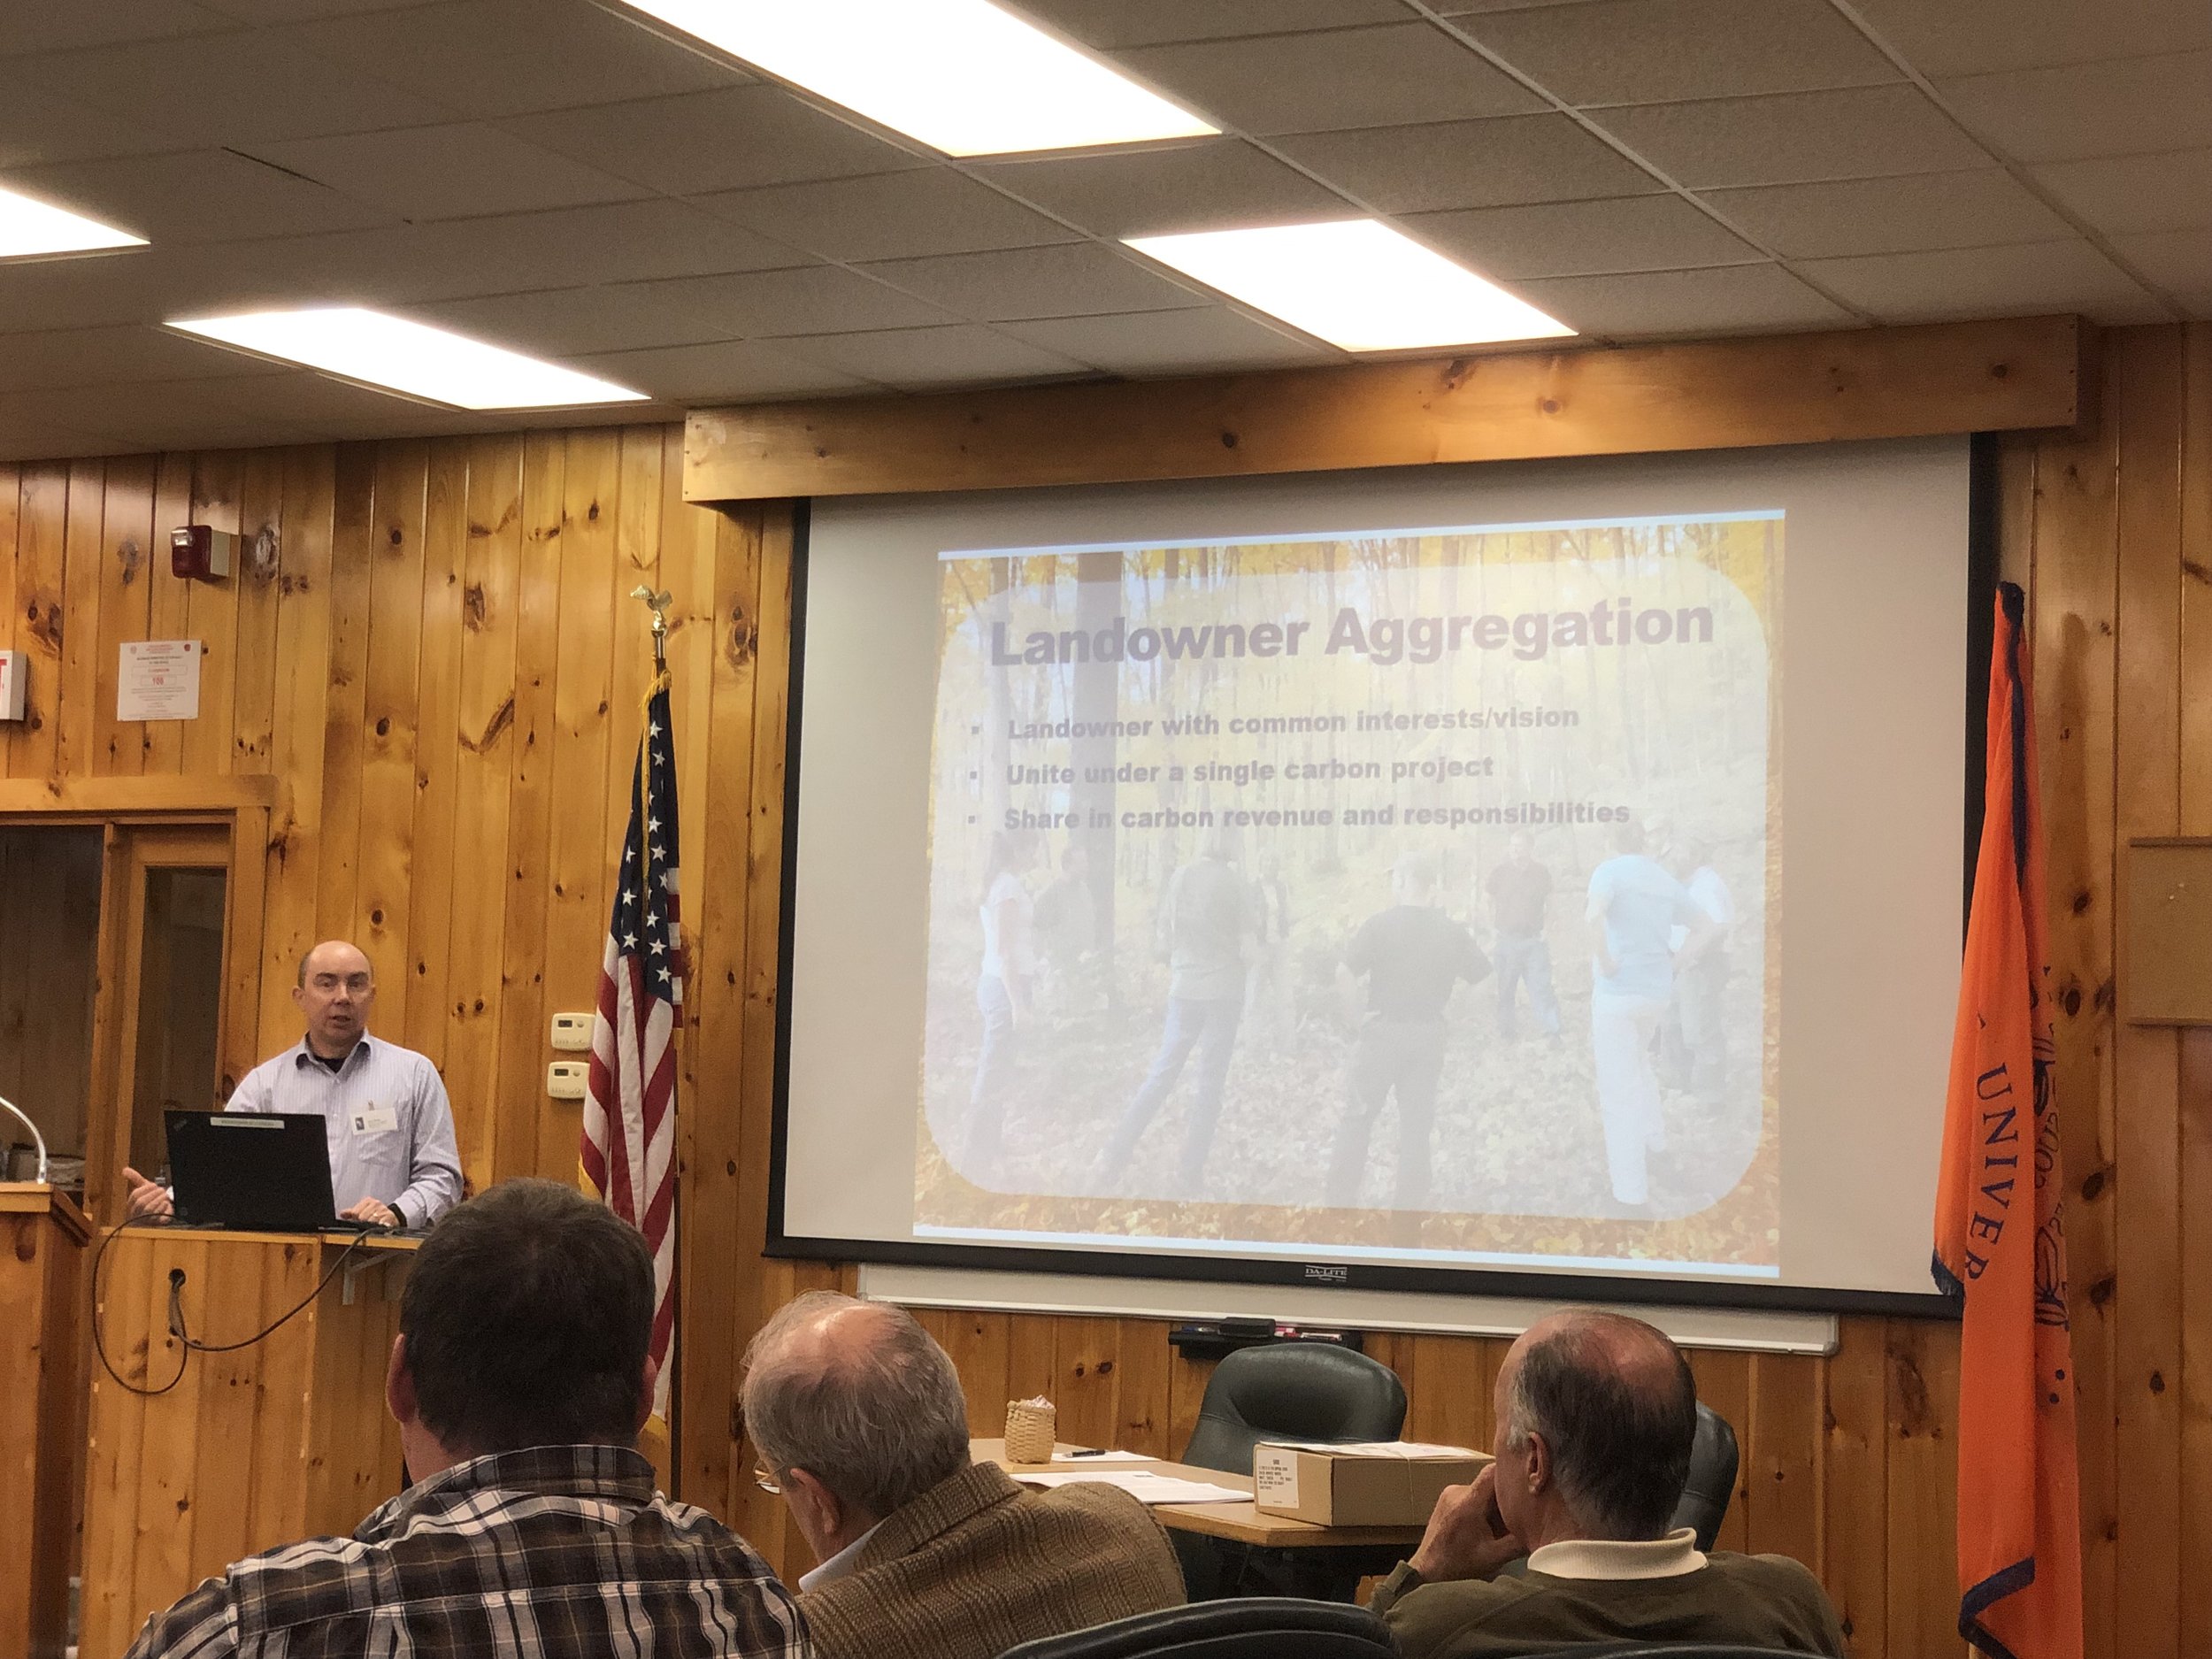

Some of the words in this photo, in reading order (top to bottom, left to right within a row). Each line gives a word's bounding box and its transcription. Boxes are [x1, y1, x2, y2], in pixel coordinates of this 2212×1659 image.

[991, 617, 1310, 666] Landowner
[1325, 596, 1714, 665] Aggregation
[1008, 718, 1153, 740] Landowner
[1161, 714, 1219, 736] with
[1229, 715, 1346, 734] common
[1356, 706, 1579, 732] interests/vision
[1006, 764, 1075, 786] Unite
[1084, 763, 1161, 784] under
[1169, 767, 1184, 782] a
[1193, 760, 1275, 787] single
[1284, 758, 1381, 780] carbon
[1391, 756, 1494, 784] project
[1004, 807, 1080, 830] Share
[1088, 808, 1112, 829] in
[1120, 806, 1215, 828] carbon
[1223, 808, 1333, 827] revenue
[1342, 804, 1394, 826] and
[1403, 801, 1630, 829] responsibilities
[1963, 1062, 2019, 1281] UNIVER
[1305, 1267, 1347, 1276] DA-LITE
